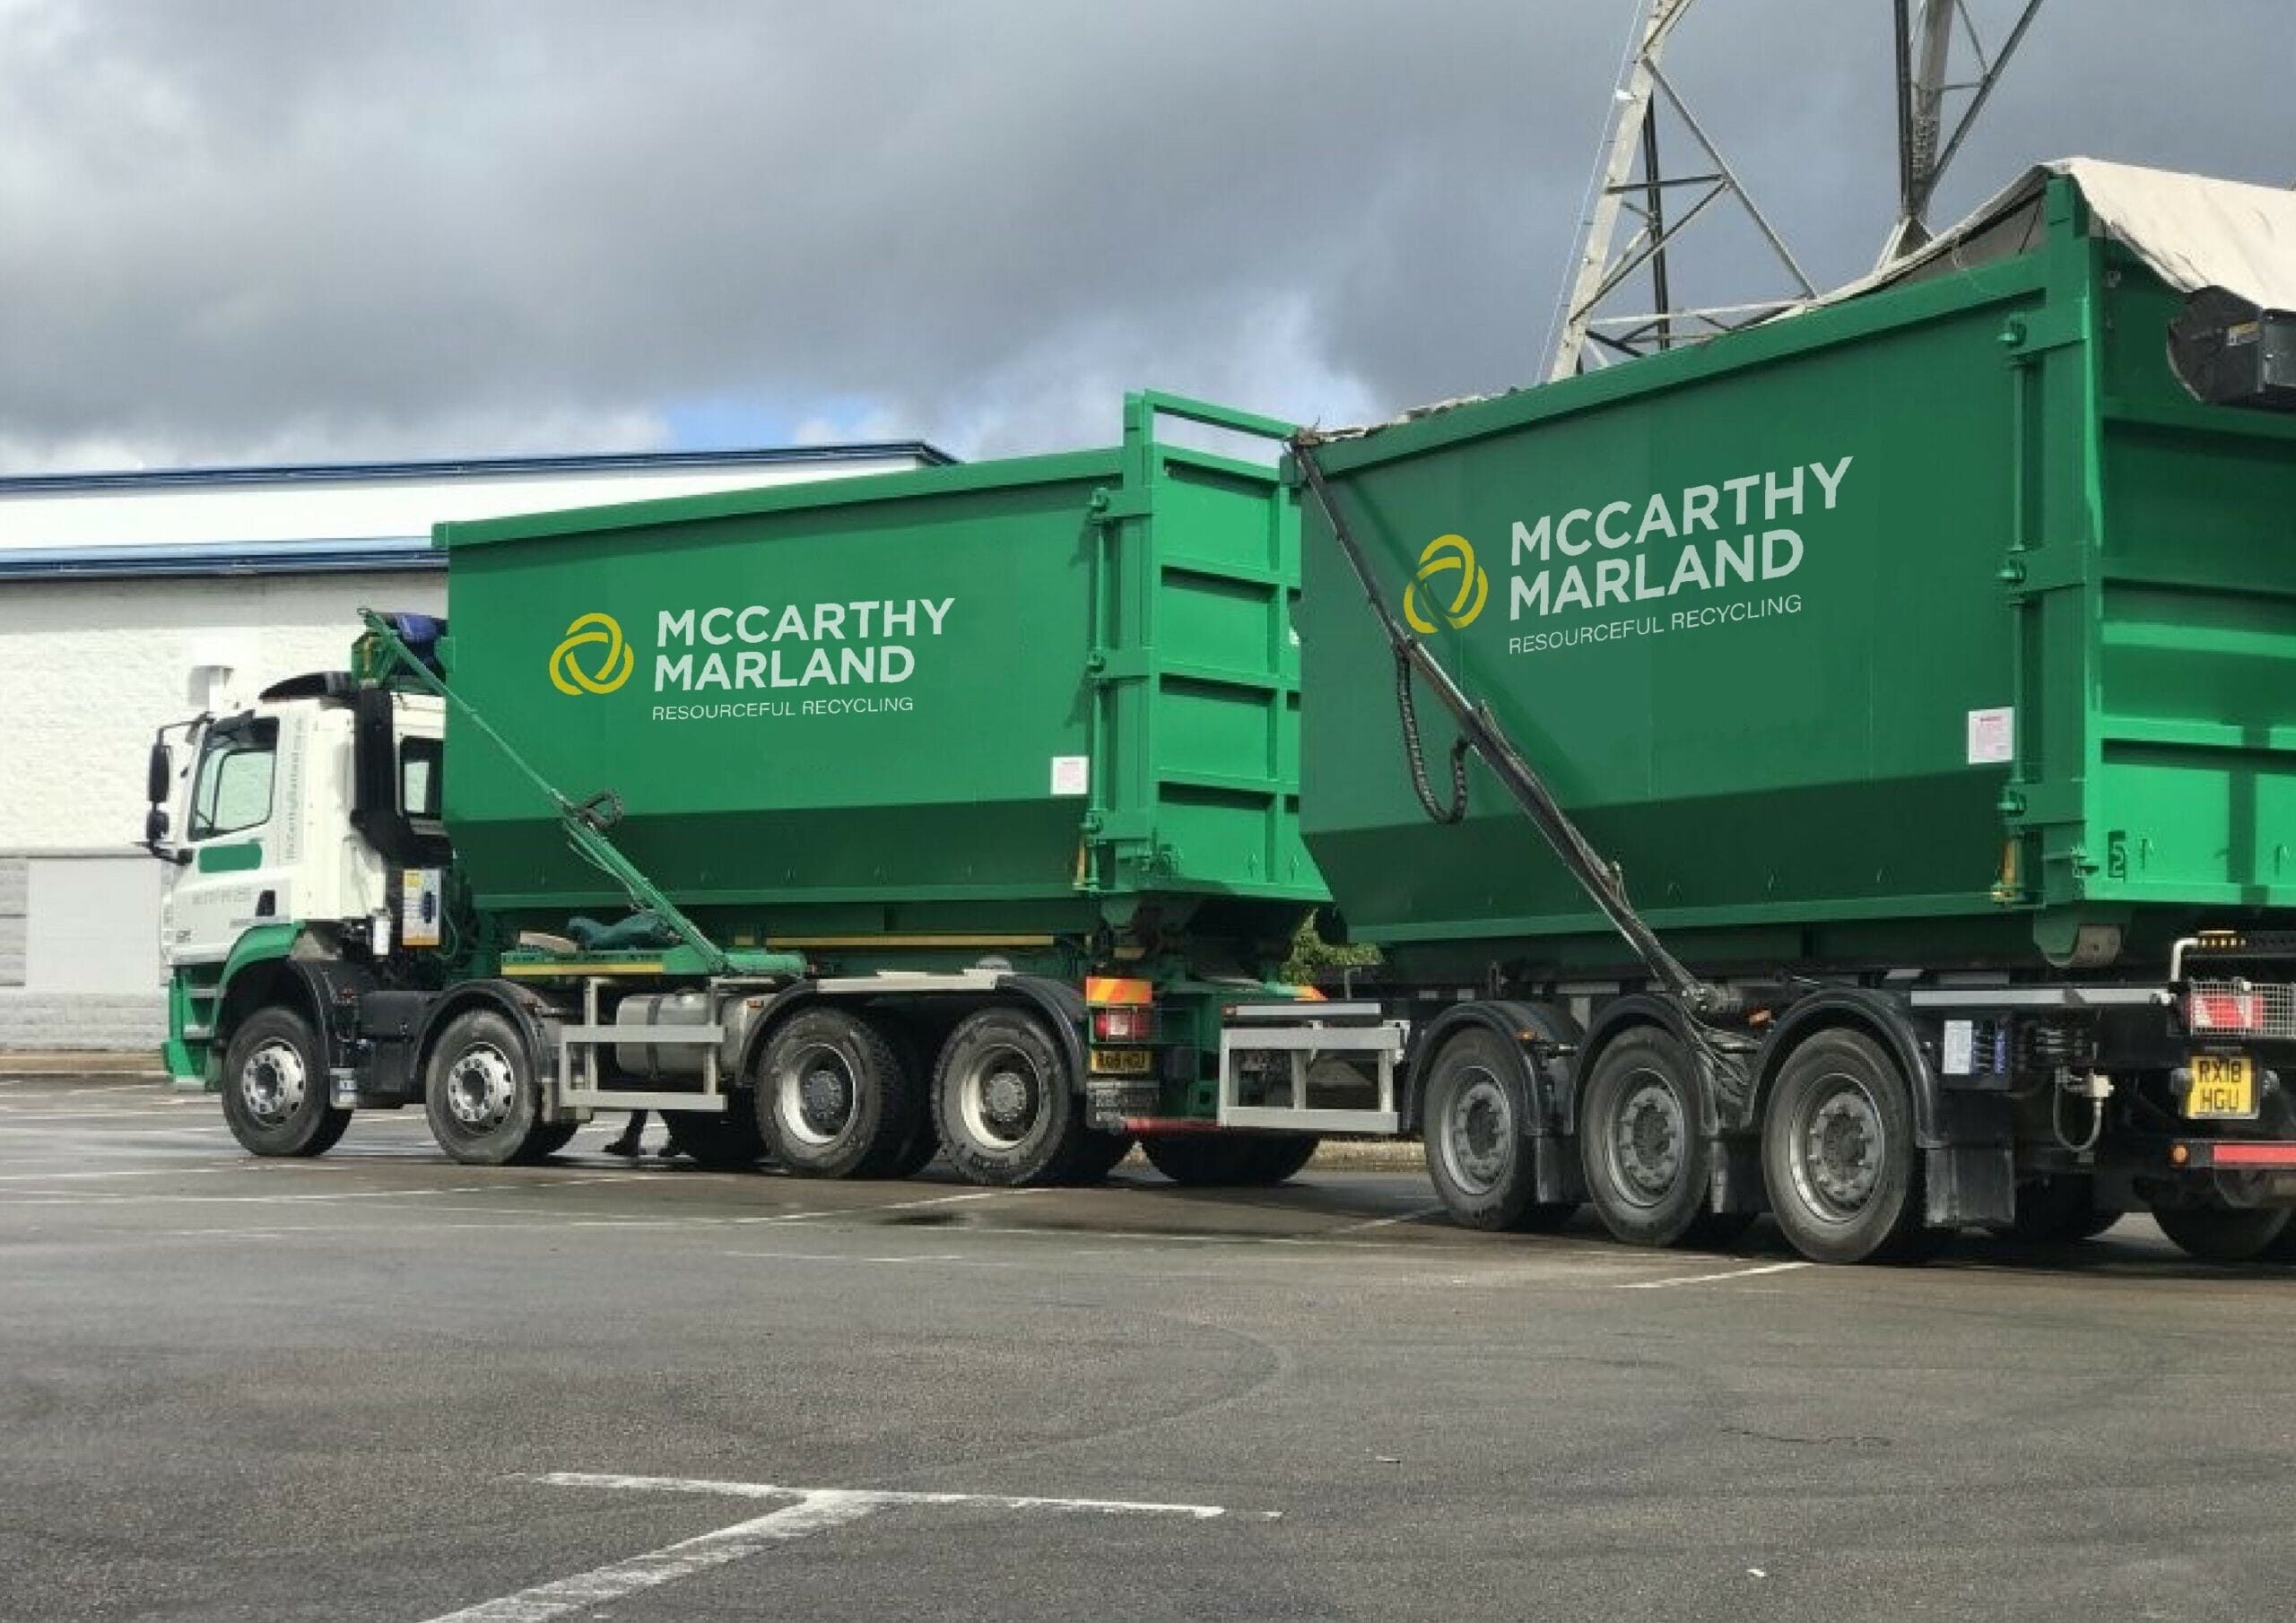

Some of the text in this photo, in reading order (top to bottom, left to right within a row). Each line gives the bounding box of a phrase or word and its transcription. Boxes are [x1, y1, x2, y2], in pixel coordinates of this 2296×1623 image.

[1510, 456, 1854, 567] MCCARTHY
[1509, 528, 1805, 621] MARLAND
[657, 597, 956, 647] MCCARTHY
[1509, 594, 1802, 655] RESOURCEFUL RECYCLING
[654, 645, 916, 692] MARLAND
[652, 697, 913, 721] RESOURCEFUL RECYCLING
[2199, 1088, 2239, 1110] HGU
